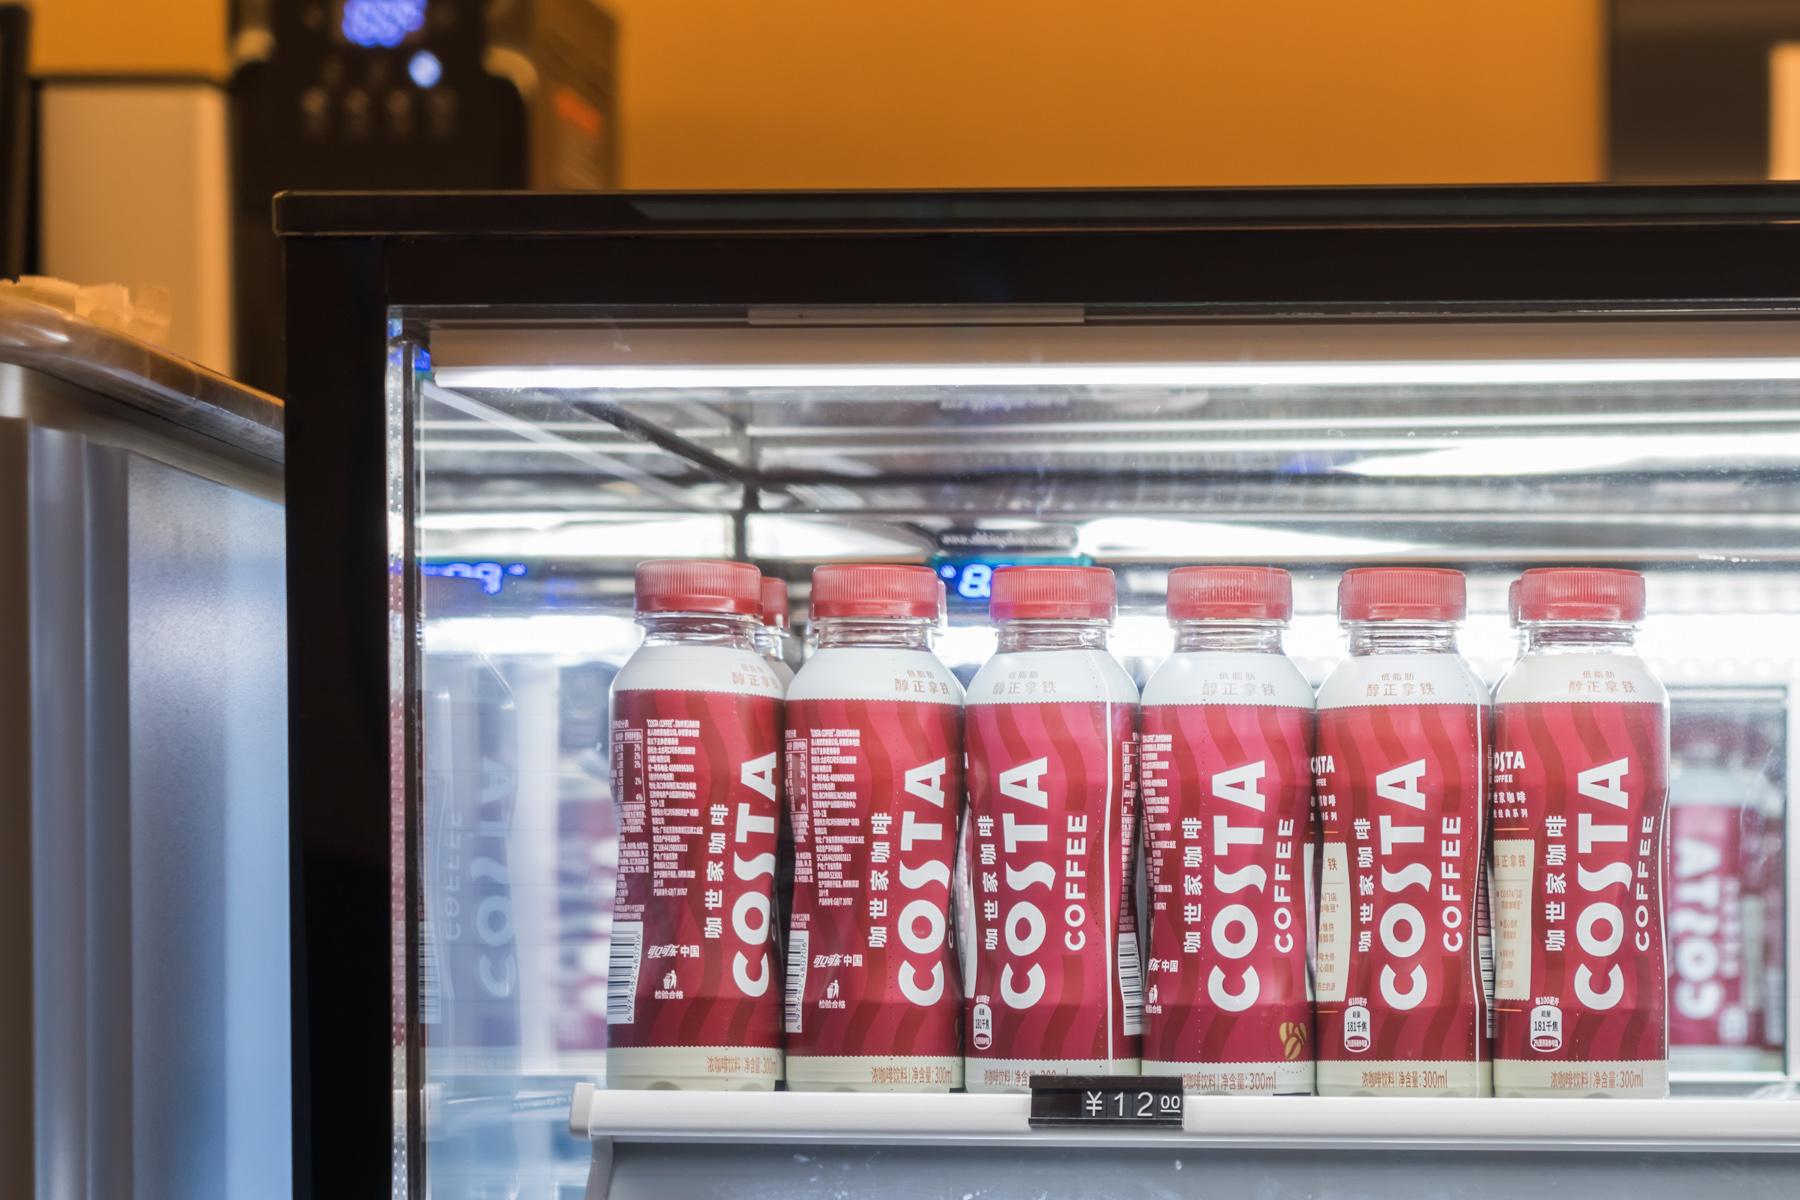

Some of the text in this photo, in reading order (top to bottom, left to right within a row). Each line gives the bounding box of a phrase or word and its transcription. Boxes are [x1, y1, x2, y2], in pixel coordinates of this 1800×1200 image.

[704, 803, 729, 939] 咖世家咖啡
[732, 751, 777, 998] COSTA
[868, 812, 892, 948] 咖世家咖啡
[898, 757, 950, 1007] COSTA
[978, 815, 998, 950] 咖世家咖啡
[1000, 756, 1056, 1010] COSTA
[1064, 815, 1088, 951] COFFEE
[1182, 817, 1203, 953] 咖世家咖啡
[1207, 759, 1267, 1012] COSTA
[1273, 818, 1294, 953] COFFEE
[1354, 817, 1374, 952] 咖世家咖啡
[1376, 758, 1433, 1011] COSTA
[1441, 816, 1463, 952] COFFEE
[1545, 815, 1567, 952] 咖世家咖啡
[1574, 757, 1633, 1011] COSTA
[1635, 815, 1654, 952] COFFEE
[654, 990, 684, 1000] 检验合格
[1534, 1021, 1558, 1032] 181千焦
